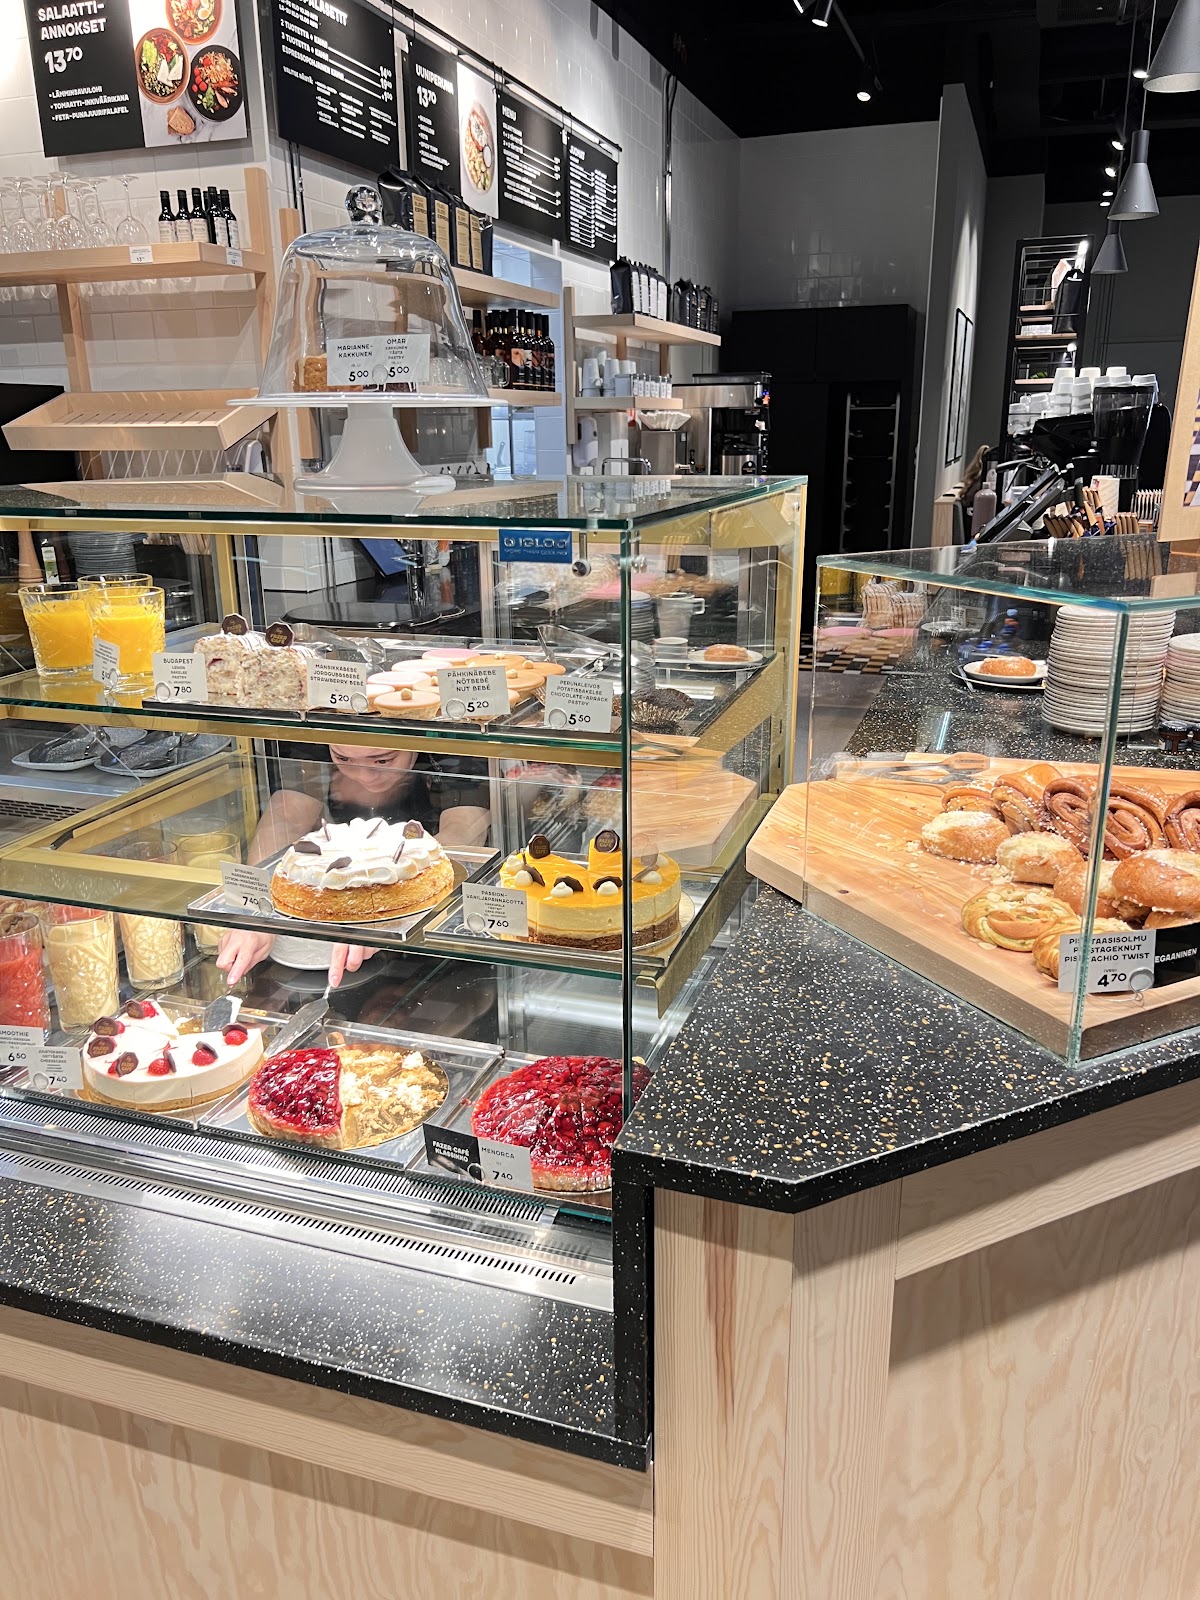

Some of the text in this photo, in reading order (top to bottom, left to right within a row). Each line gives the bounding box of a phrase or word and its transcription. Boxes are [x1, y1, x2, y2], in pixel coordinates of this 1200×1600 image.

[38, 1, 105, 22] SALAATTI-
[40, 18, 106, 40] ANNOKSET
[315, 664, 358, 673] MANSIKKABEBE
[447, 670, 496, 678] PÄHKINÄBEBE
[310, 676, 349, 686] STRAWBERRY
[456, 677, 488, 685] NÖTBEBÉ
[1074, 945, 1141, 953] PSTAGEKNUT
[1155, 948, 1197, 963] EGAANINEN
[433, 1141, 470, 1156] FAZER CAFÉ
[435, 1147, 469, 1162] KLASSIKKO
[481, 1147, 515, 1159] MENORCA
